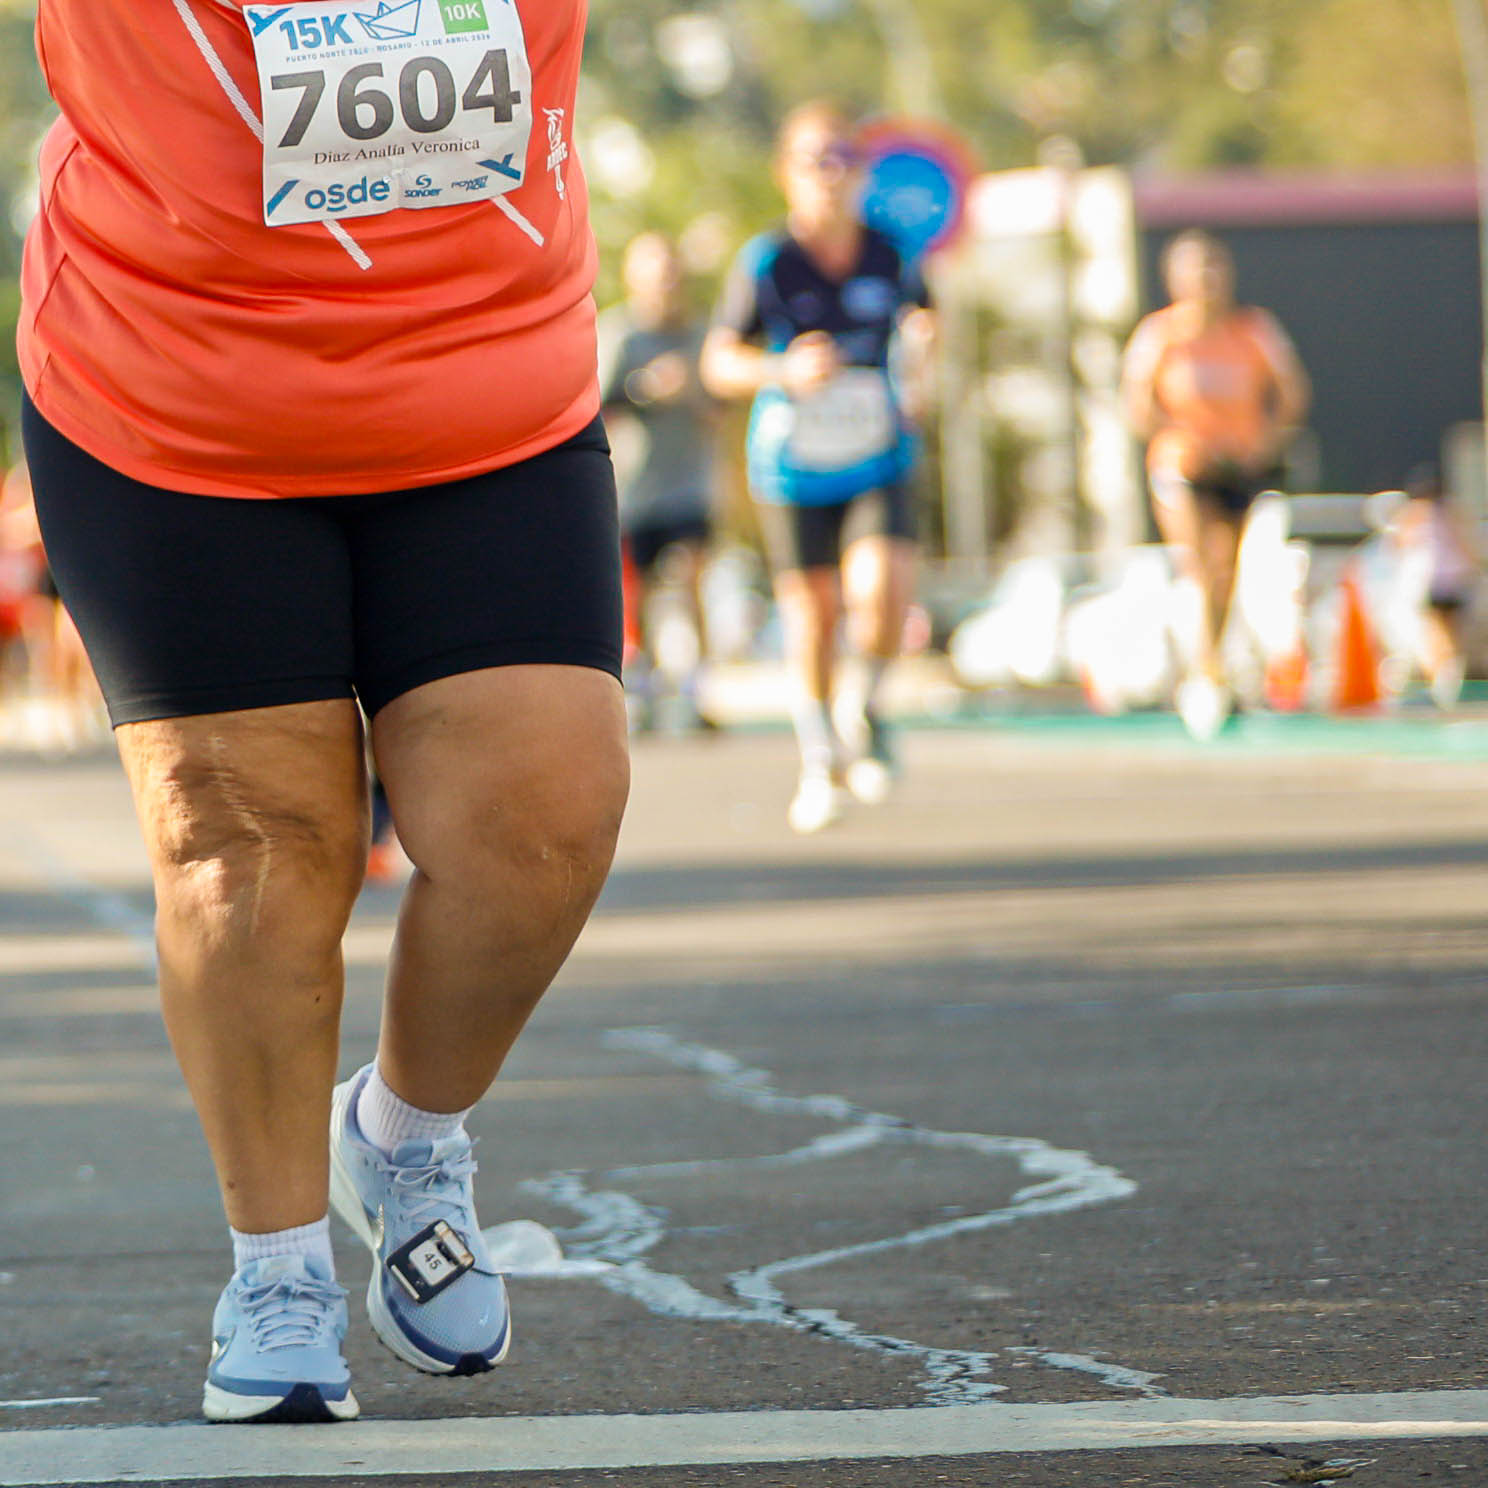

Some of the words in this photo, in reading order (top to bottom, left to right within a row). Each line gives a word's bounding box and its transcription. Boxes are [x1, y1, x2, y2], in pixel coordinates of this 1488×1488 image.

[444, 2, 481, 22] 10K
[279, 13, 355, 50] 15K
[445, 35, 469, 45] ABRIL
[270, 48, 521, 148] 7604
[355, 144, 405, 160] Analía
[411, 138, 480, 155] Veronica
[305, 176, 390, 211] osde
[425, 1253, 443, 1270] 45
